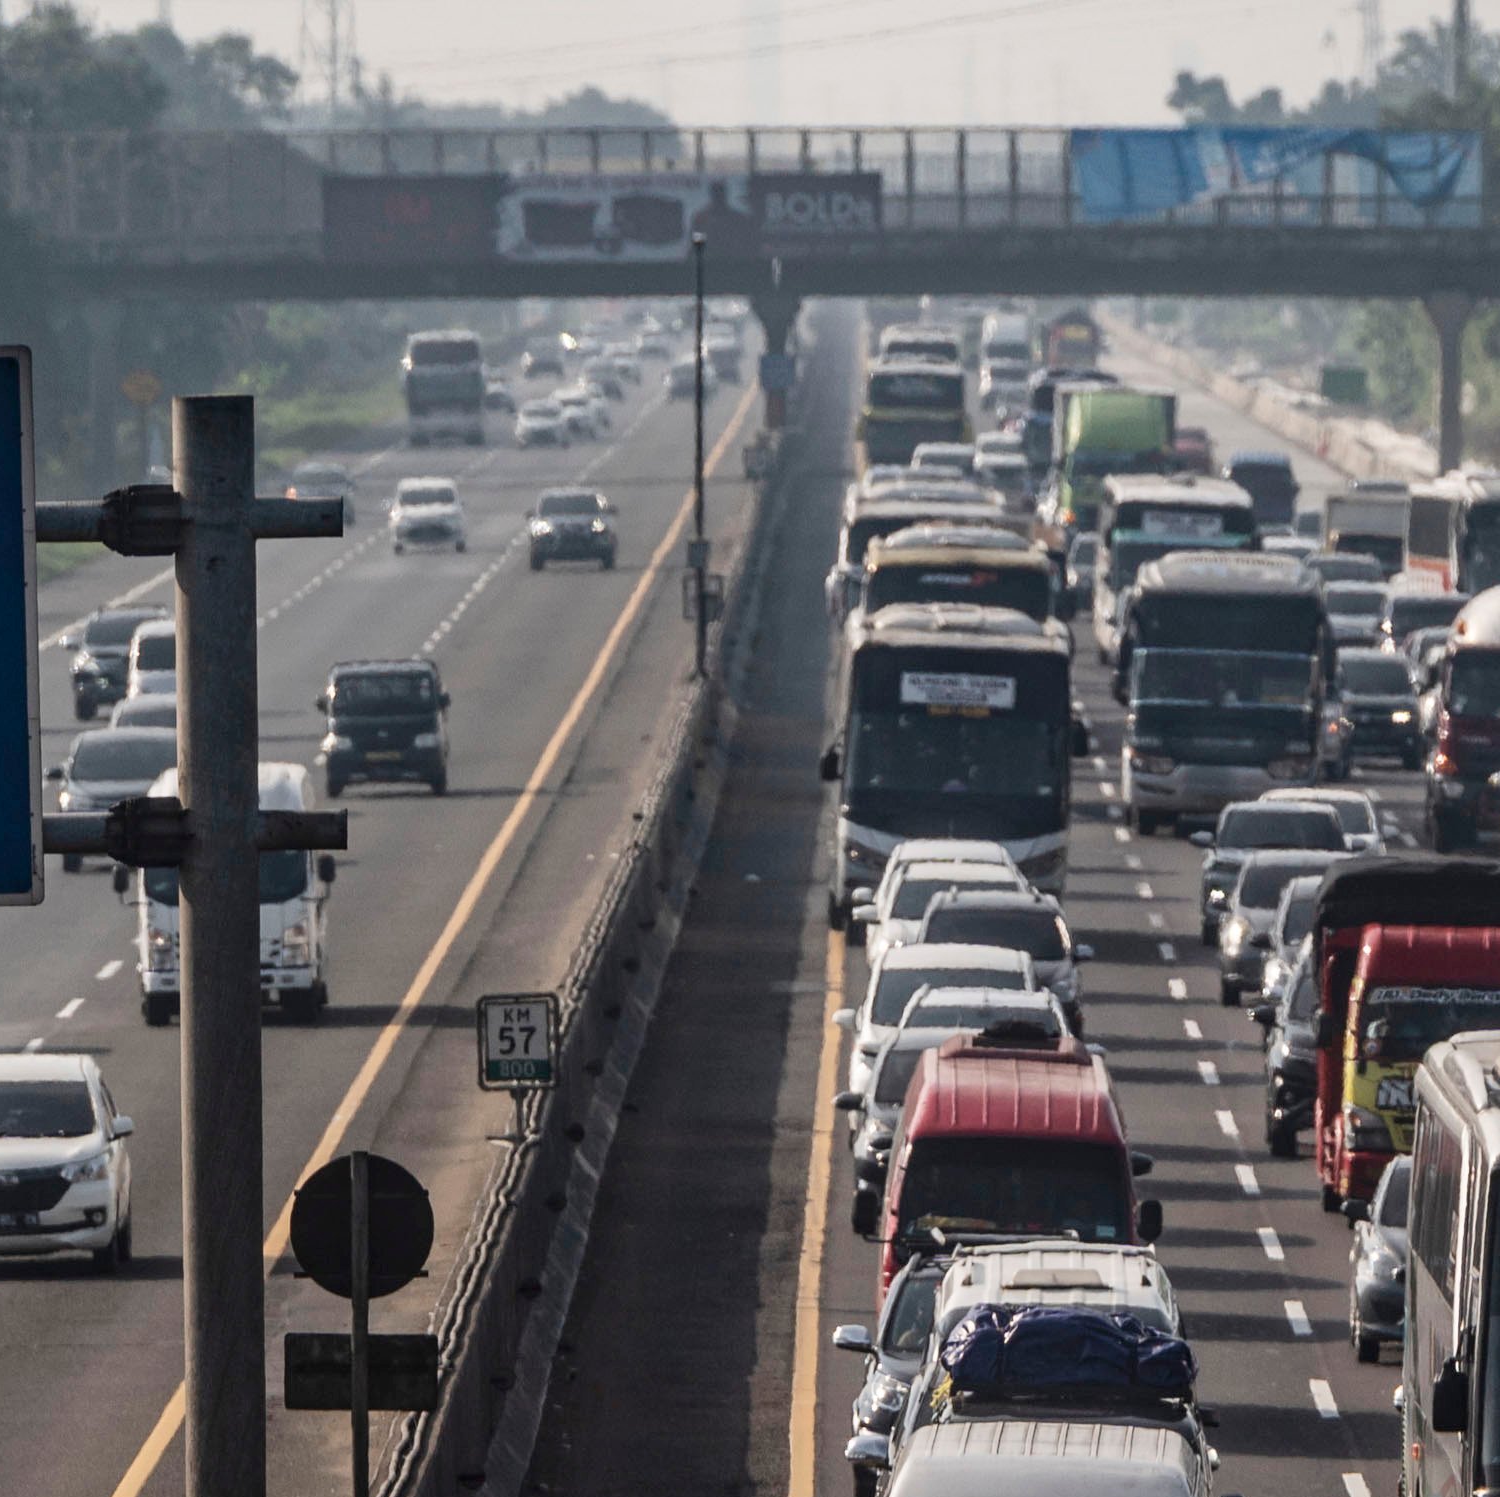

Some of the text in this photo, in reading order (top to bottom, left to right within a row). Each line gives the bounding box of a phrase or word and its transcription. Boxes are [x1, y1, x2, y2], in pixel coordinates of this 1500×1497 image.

[503, 1007, 530, 1024] KM
[499, 1026, 537, 1055] 57
[499, 1060, 536, 1078] 800
